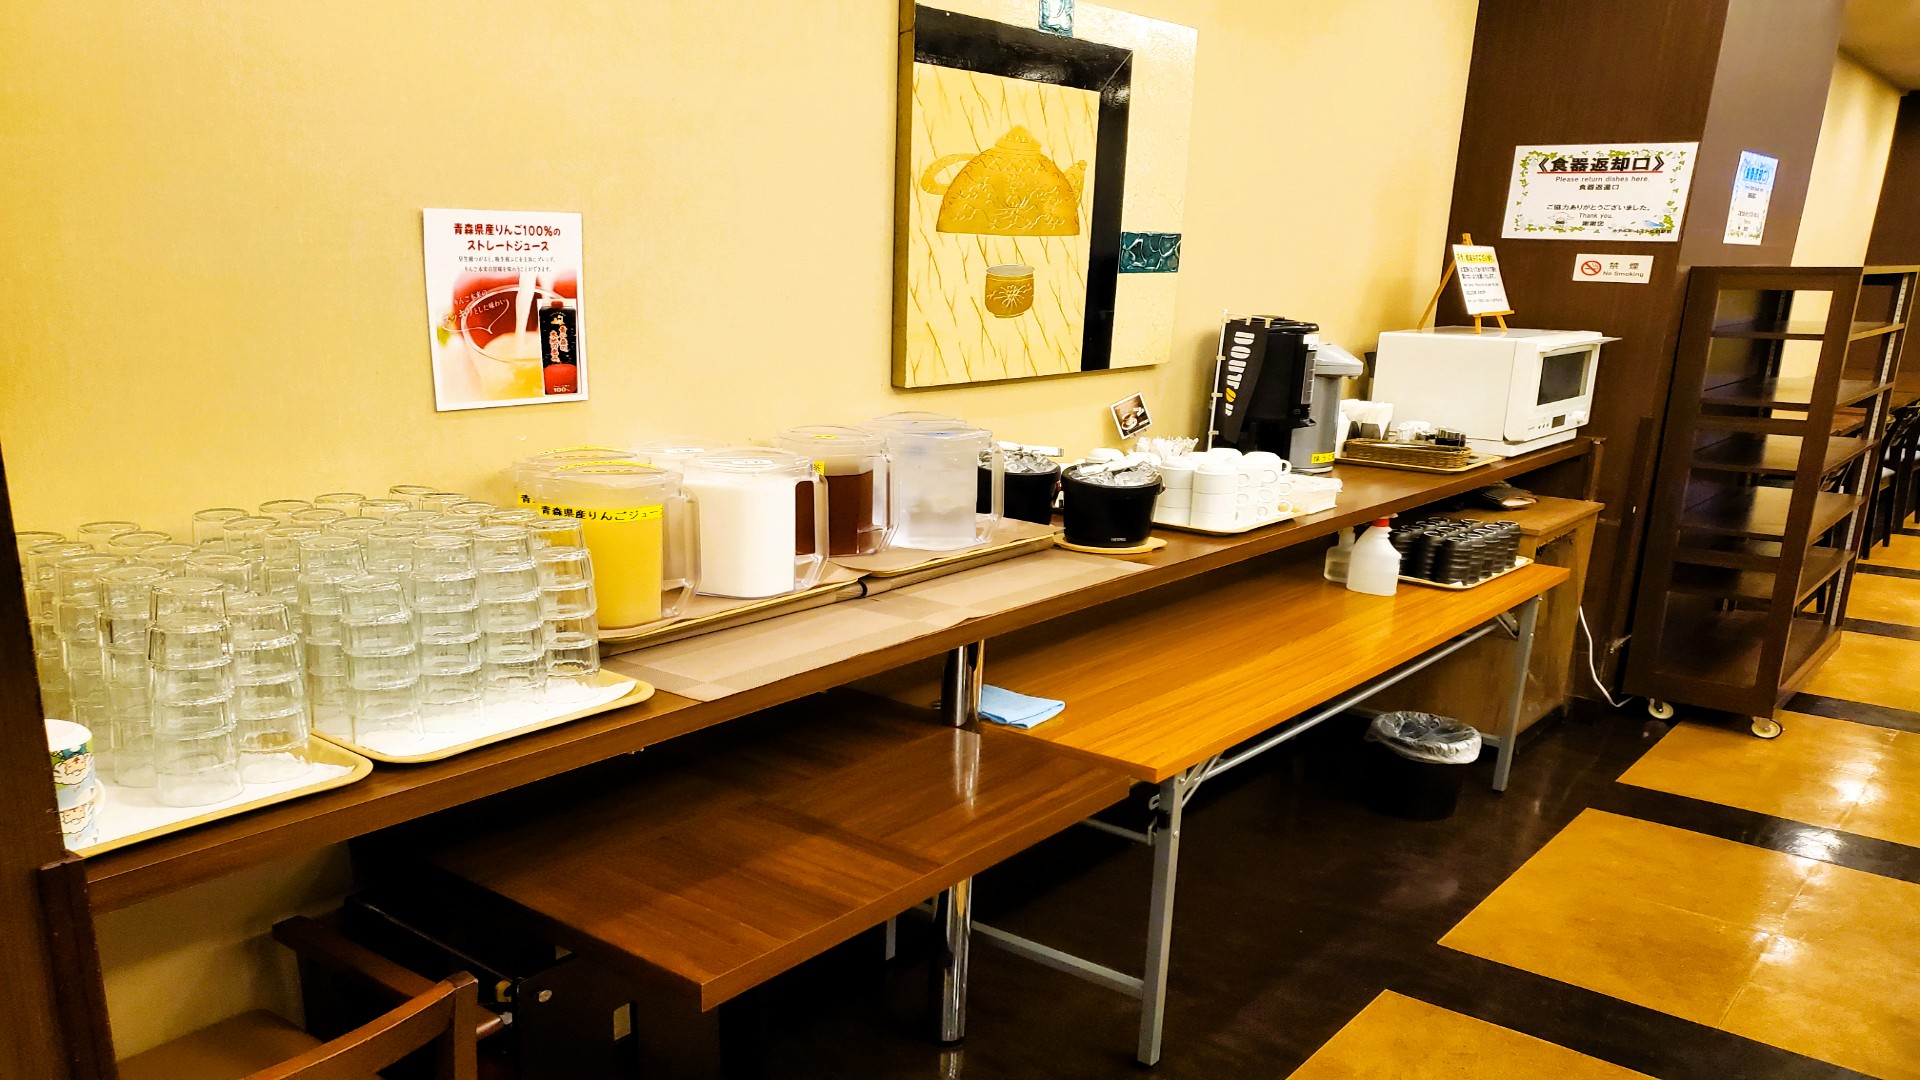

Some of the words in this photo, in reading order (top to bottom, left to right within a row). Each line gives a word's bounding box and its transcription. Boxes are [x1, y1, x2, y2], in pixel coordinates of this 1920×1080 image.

[453, 223, 561, 237] 青森県産りんご100%の
[467, 240, 549, 251] ストレートジュース
[1614, 270, 1645, 278] Smoking
[1225, 331, 1255, 416] DOUTOR
